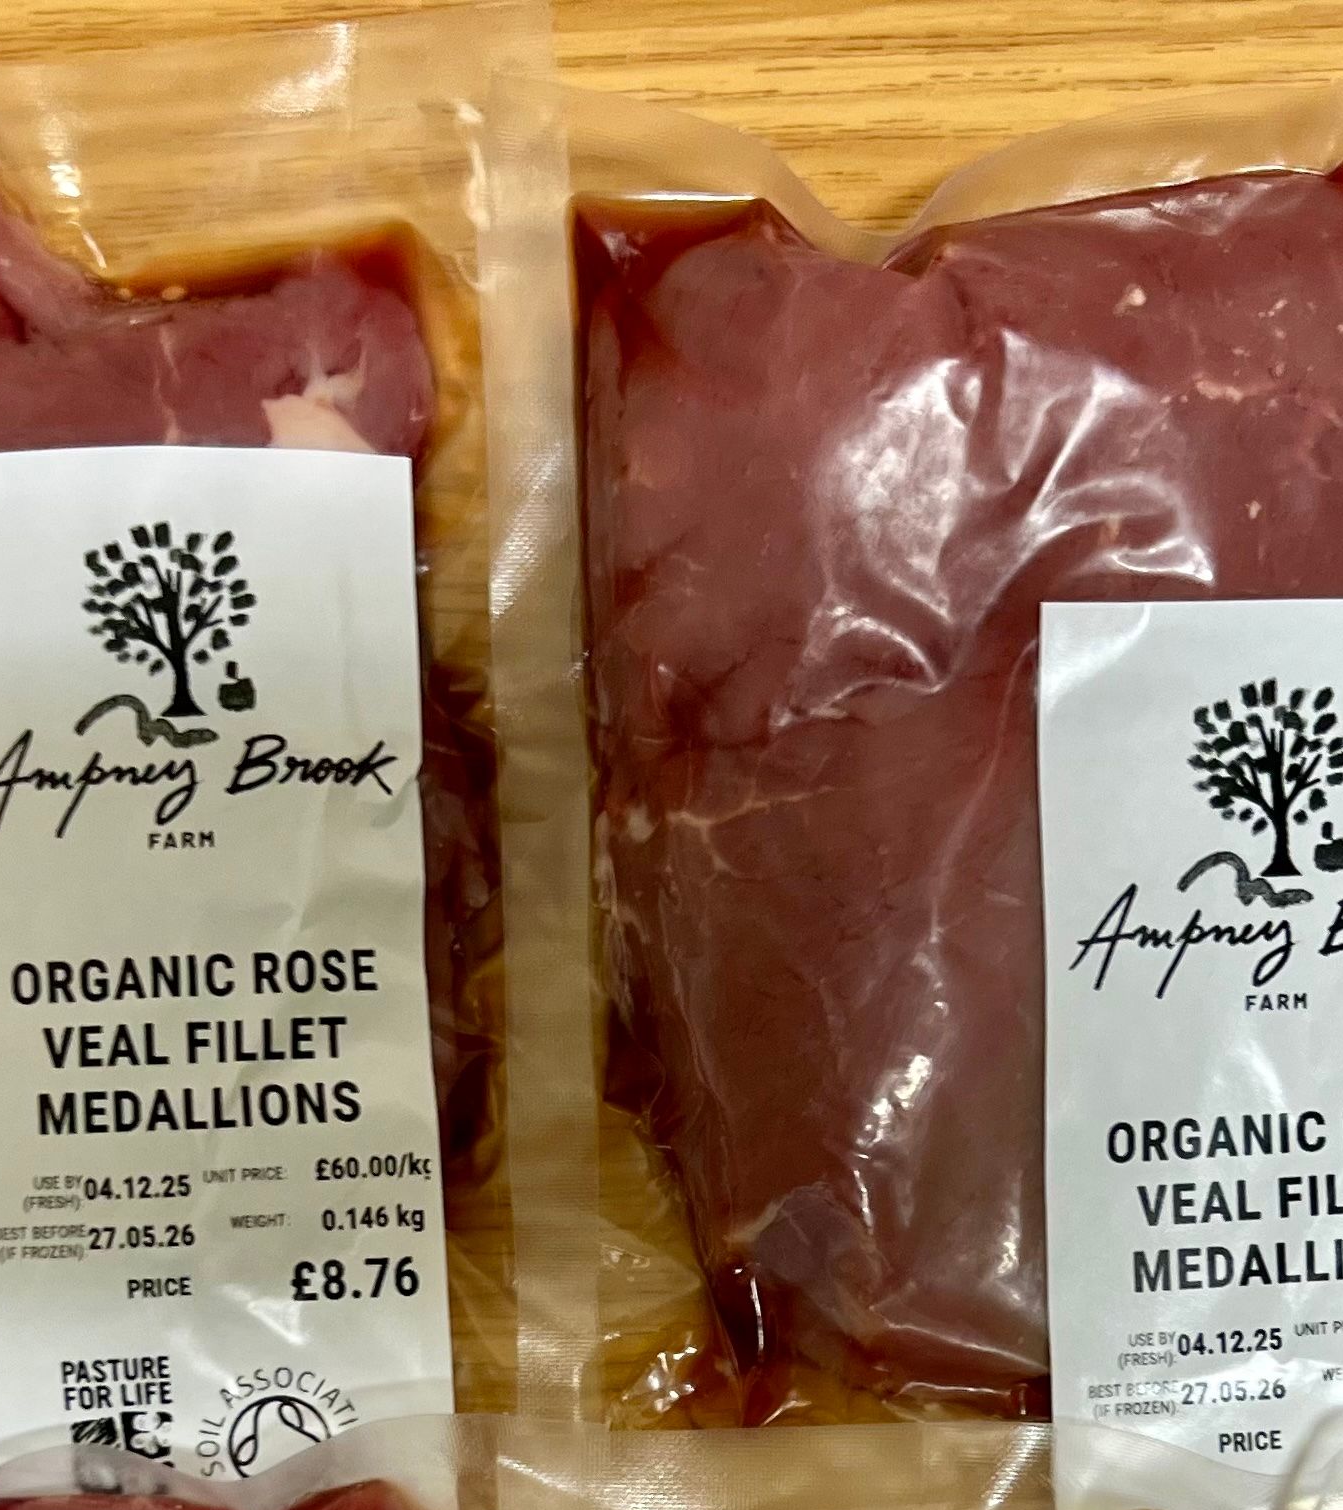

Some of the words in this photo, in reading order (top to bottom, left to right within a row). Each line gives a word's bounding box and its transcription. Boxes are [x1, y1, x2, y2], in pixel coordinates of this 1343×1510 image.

[225, 734, 398, 796] Brook
[148, 833, 215, 851] FARM
[1068, 884, 1295, 999] Ampney
[12, 953, 236, 1005] ORGANIC
[254, 949, 379, 994] ROSE
[1245, 993, 1308, 1012] FARM
[43, 1023, 170, 1068] VEAL
[186, 1016, 347, 1065] FILLET
[38, 1080, 362, 1135] MEDALLIONS
[1107, 1111, 1326, 1163] ORGANIC
[33, 1175, 60, 1190] USE
[64, 1175, 83, 1188] BY
[84, 1174, 192, 1200] 04.12.25
[202, 1168, 236, 1183] UNIT
[321, 1206, 389, 1231] 0.146
[397, 1203, 425, 1232] kg
[1137, 1180, 1260, 1227] VEAL
[88, 1224, 196, 1250] 27.05.26
[127, 1277, 192, 1299] PRICE
[291, 1256, 420, 1300] £8.76
[1128, 1332, 1154, 1347] USE
[1159, 1331, 1176, 1345] BY
[1178, 1327, 1283, 1356] 04.12.25
[1294, 1321, 1328, 1336] UNIT
[60, 1355, 170, 1384] PASTURE
[63, 1386, 112, 1411] FOR
[120, 1381, 173, 1406] LIFE
[1088, 1383, 1121, 1399] BEST
[1181, 1377, 1287, 1405] 27.05.26
[194, 1415, 226, 1477] SOIL
[219, 1366, 359, 1429] ASSOCIATI
[1218, 1431, 1282, 1453] PRICE
